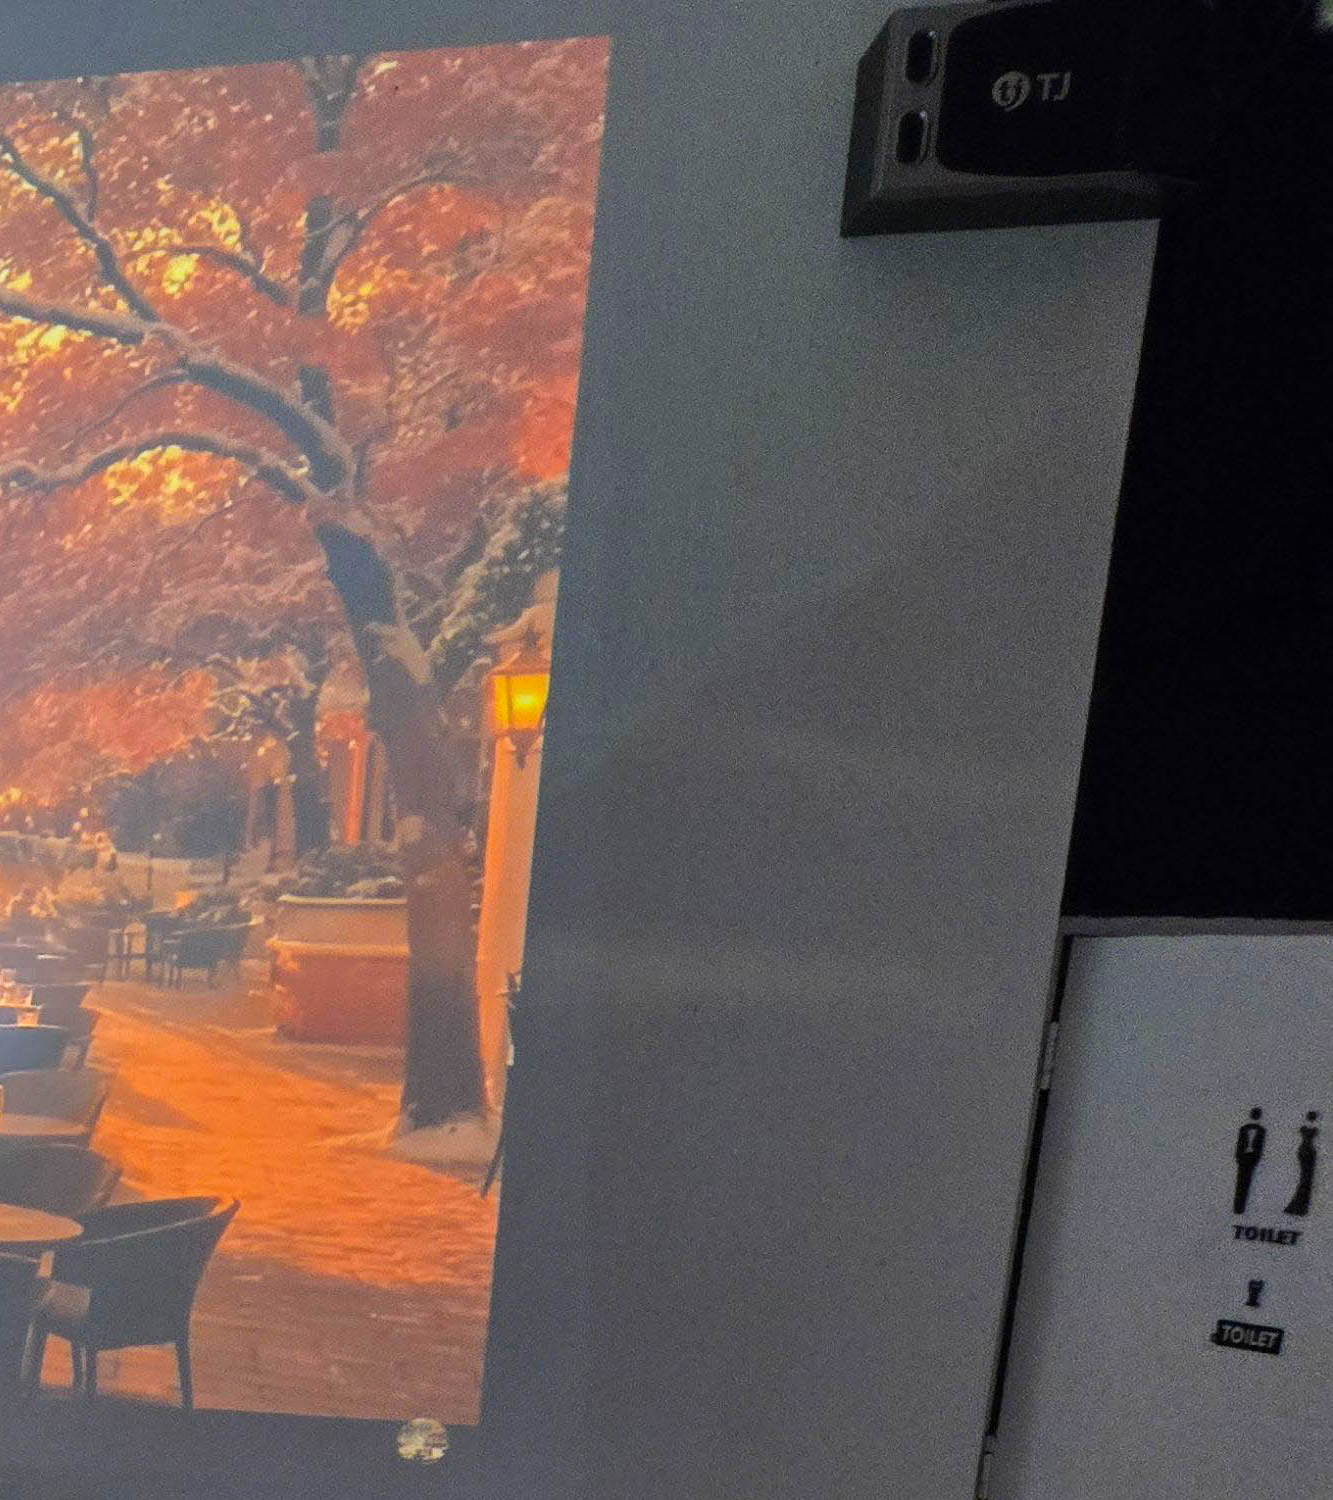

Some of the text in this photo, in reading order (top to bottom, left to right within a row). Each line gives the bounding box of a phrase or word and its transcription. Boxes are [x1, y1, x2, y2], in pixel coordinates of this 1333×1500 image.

[1036, 72, 1072, 102] TJ
[1233, 1224, 1302, 1245] TOILET
[1221, 1325, 1278, 1349] TOILET
